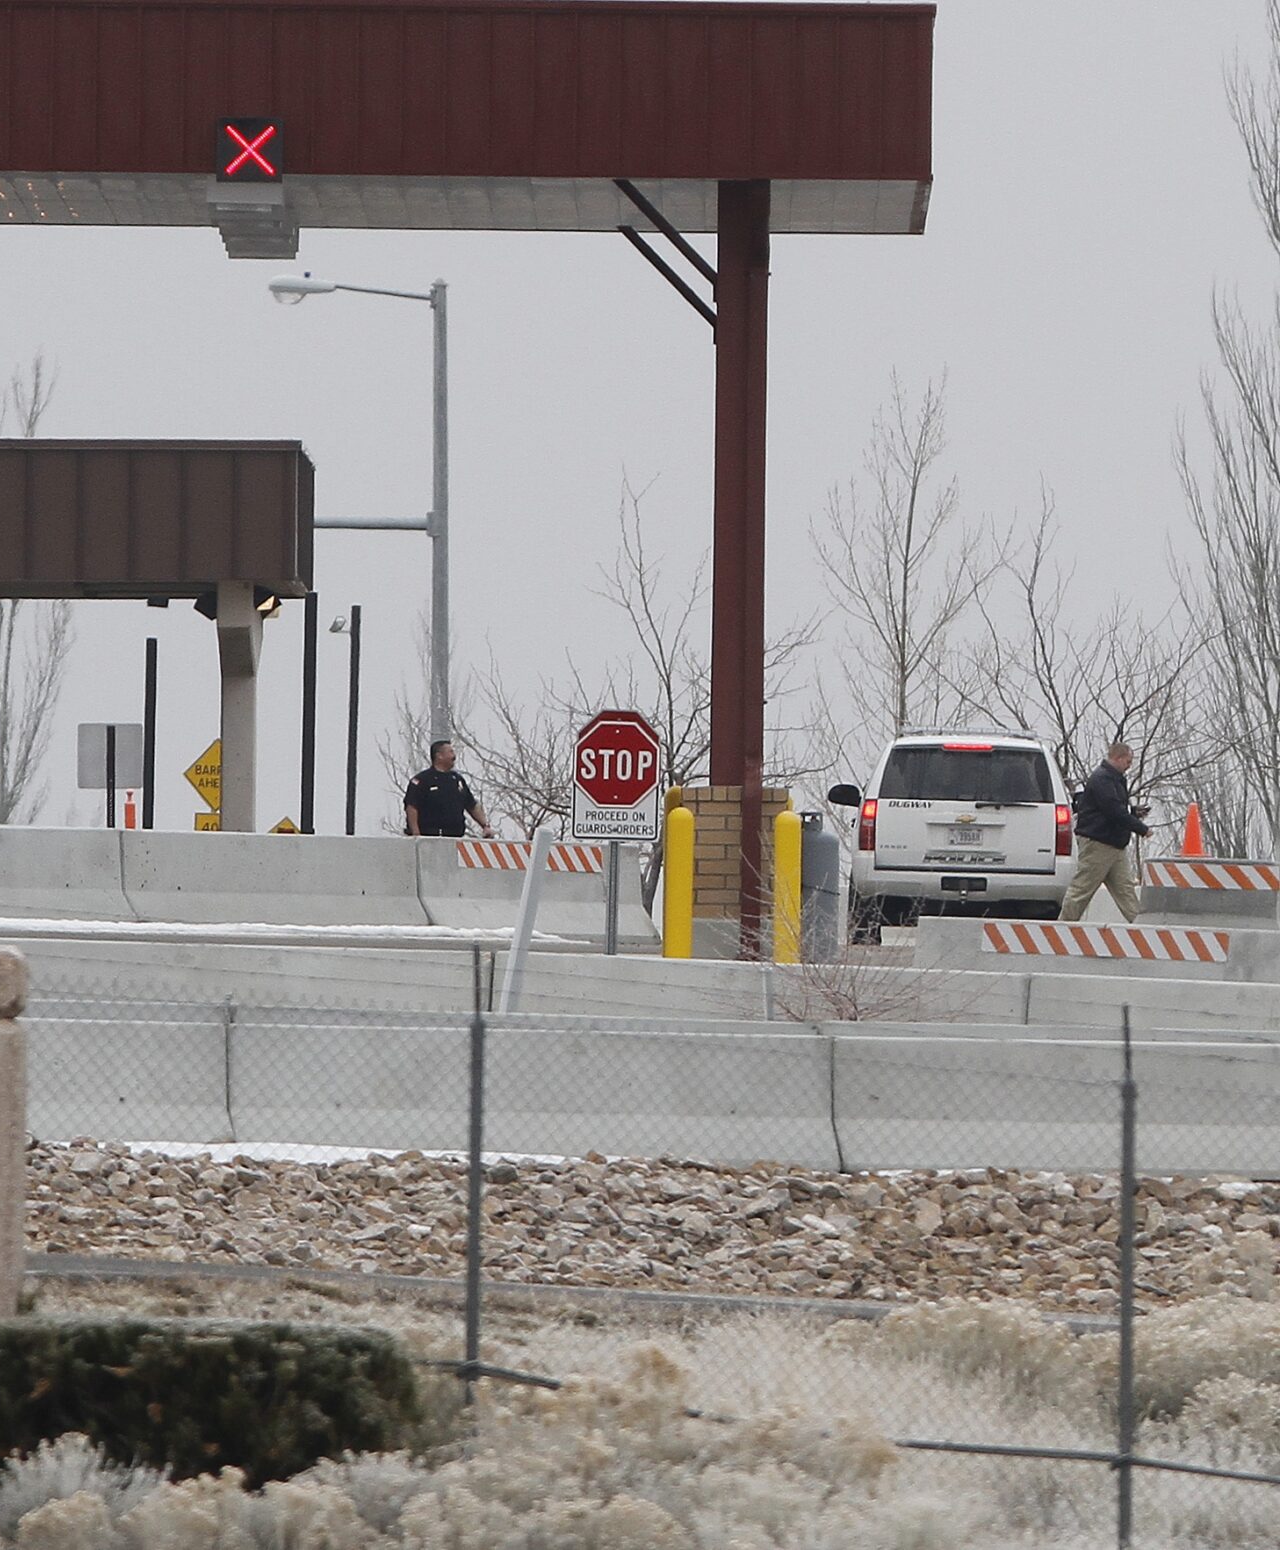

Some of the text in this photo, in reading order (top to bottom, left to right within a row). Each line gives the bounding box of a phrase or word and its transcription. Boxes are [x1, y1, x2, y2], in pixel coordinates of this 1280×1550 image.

[580, 748, 653, 780] STOP
[198, 778, 219, 788] AHE
[888, 801, 934, 809] DUGWAY
[585, 810, 645, 822] PROCEED ON
